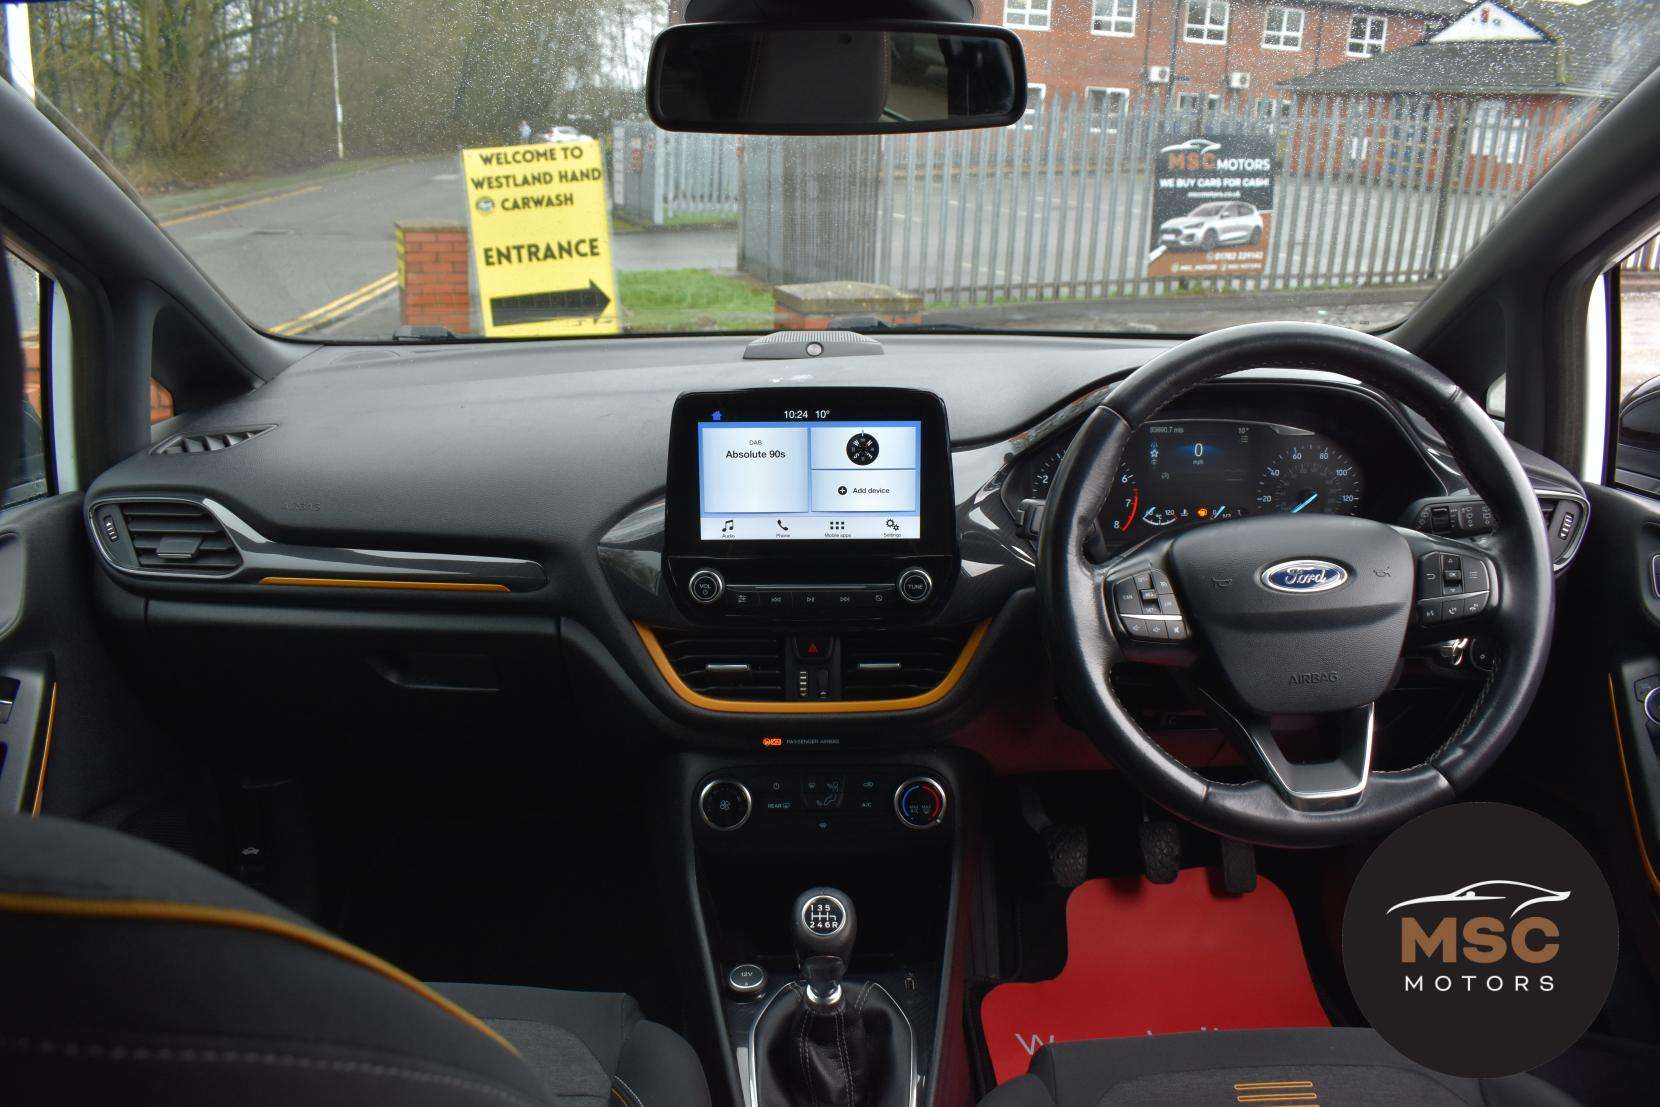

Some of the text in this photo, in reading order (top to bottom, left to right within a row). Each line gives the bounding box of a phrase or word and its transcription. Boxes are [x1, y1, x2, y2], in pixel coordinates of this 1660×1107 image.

[479, 146, 583, 166] WELCOME TO
[1168, 152, 1271, 171] MSC MOTORS
[471, 168, 602, 190] WESTLAND HAND
[1159, 178, 1175, 188] WE
[1176, 178, 1196, 188] BUY
[1197, 178, 1221, 188] CARS
[1223, 178, 1241, 188] FOR
[501, 193, 574, 211] CARWASH
[484, 238, 600, 266] ENTRANCE
[783, 410, 830, 419] 10:24 10°
[726, 449, 786, 459] Absolute 90s
[1194, 442, 1203, 457] 0
[1042, 475, 1049, 484] 2
[1122, 475, 1128, 483] 6
[852, 486, 890, 494] Add device
[1124, 499, 1131, 507] 7
[1114, 520, 1120, 529] 8
[1282, 565, 1326, 585] Ford
[1287, 671, 1339, 687] AIRBAG
